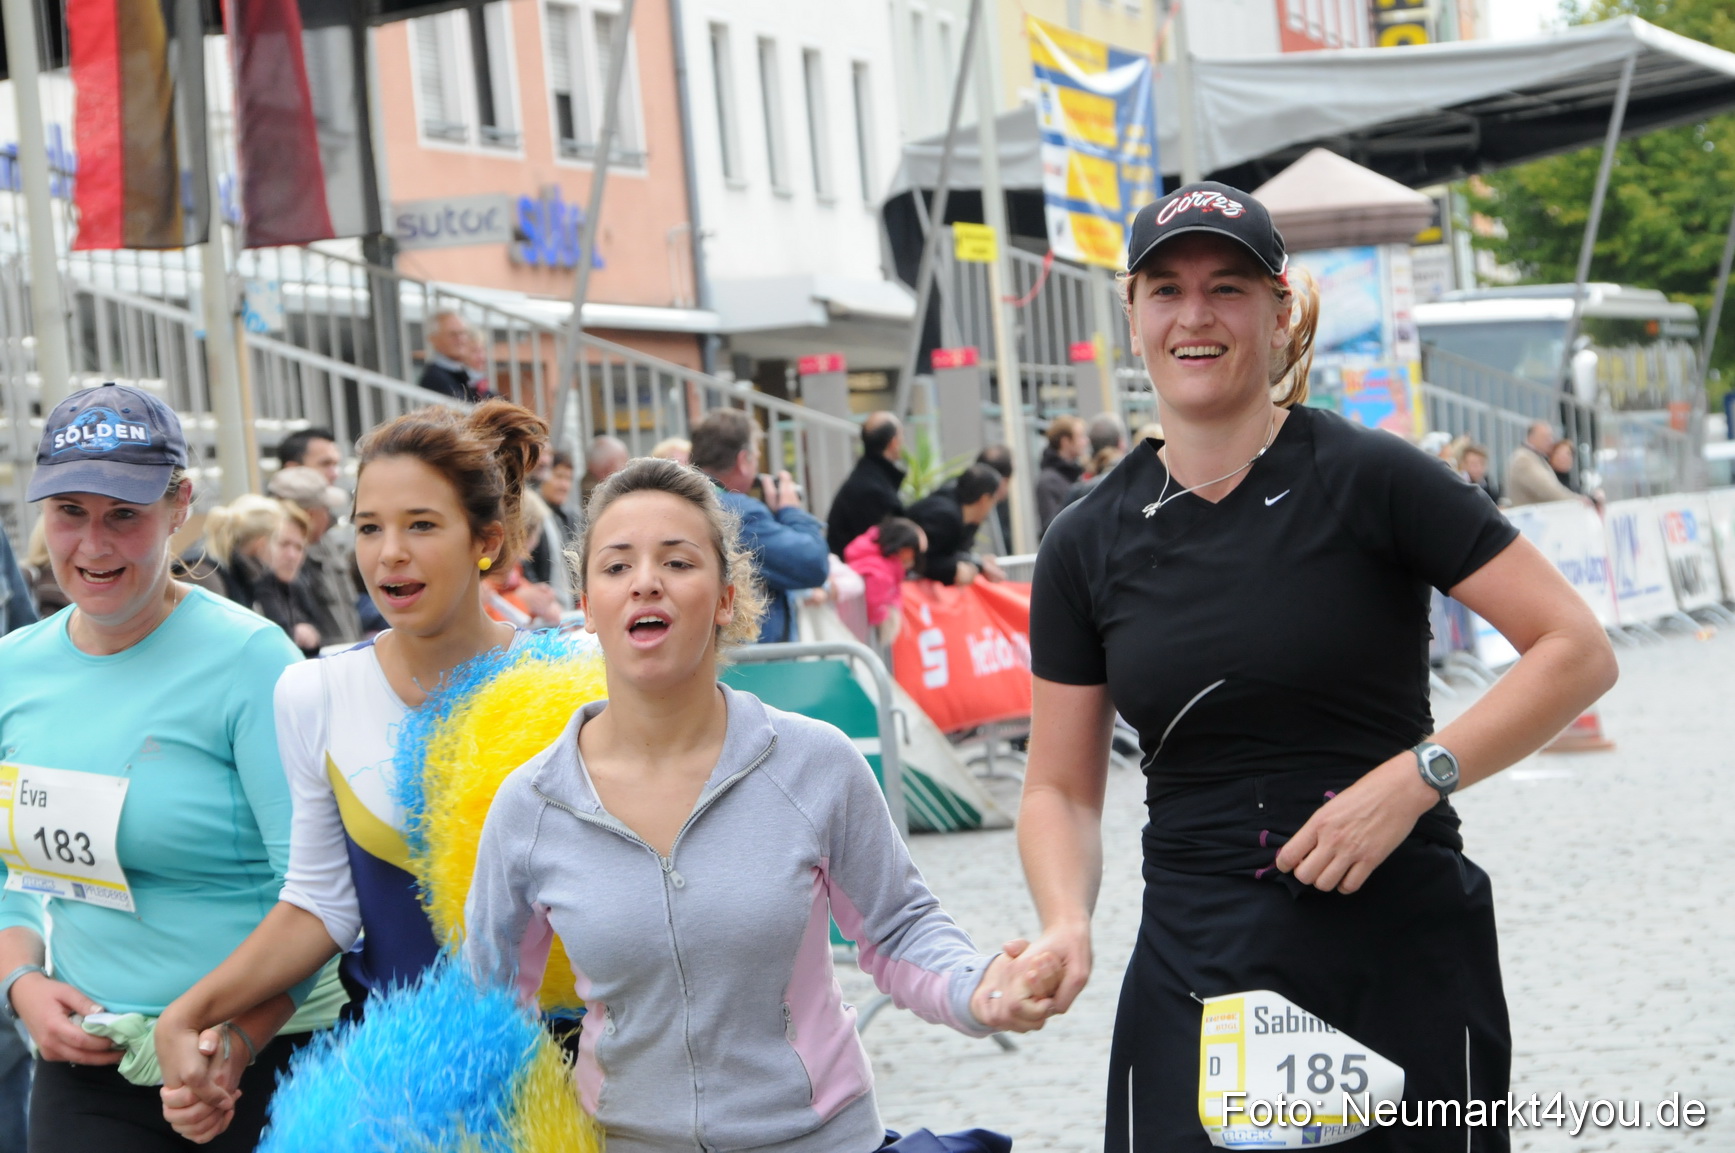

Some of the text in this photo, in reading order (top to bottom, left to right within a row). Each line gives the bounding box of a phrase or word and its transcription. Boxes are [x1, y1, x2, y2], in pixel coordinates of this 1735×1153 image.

[396, 204, 499, 240] sutor
[20, 779, 48, 808] Eva
[33, 826, 96, 867] 183
[1209, 1056, 1221, 1077] D
[1276, 1053, 1369, 1095] 185
